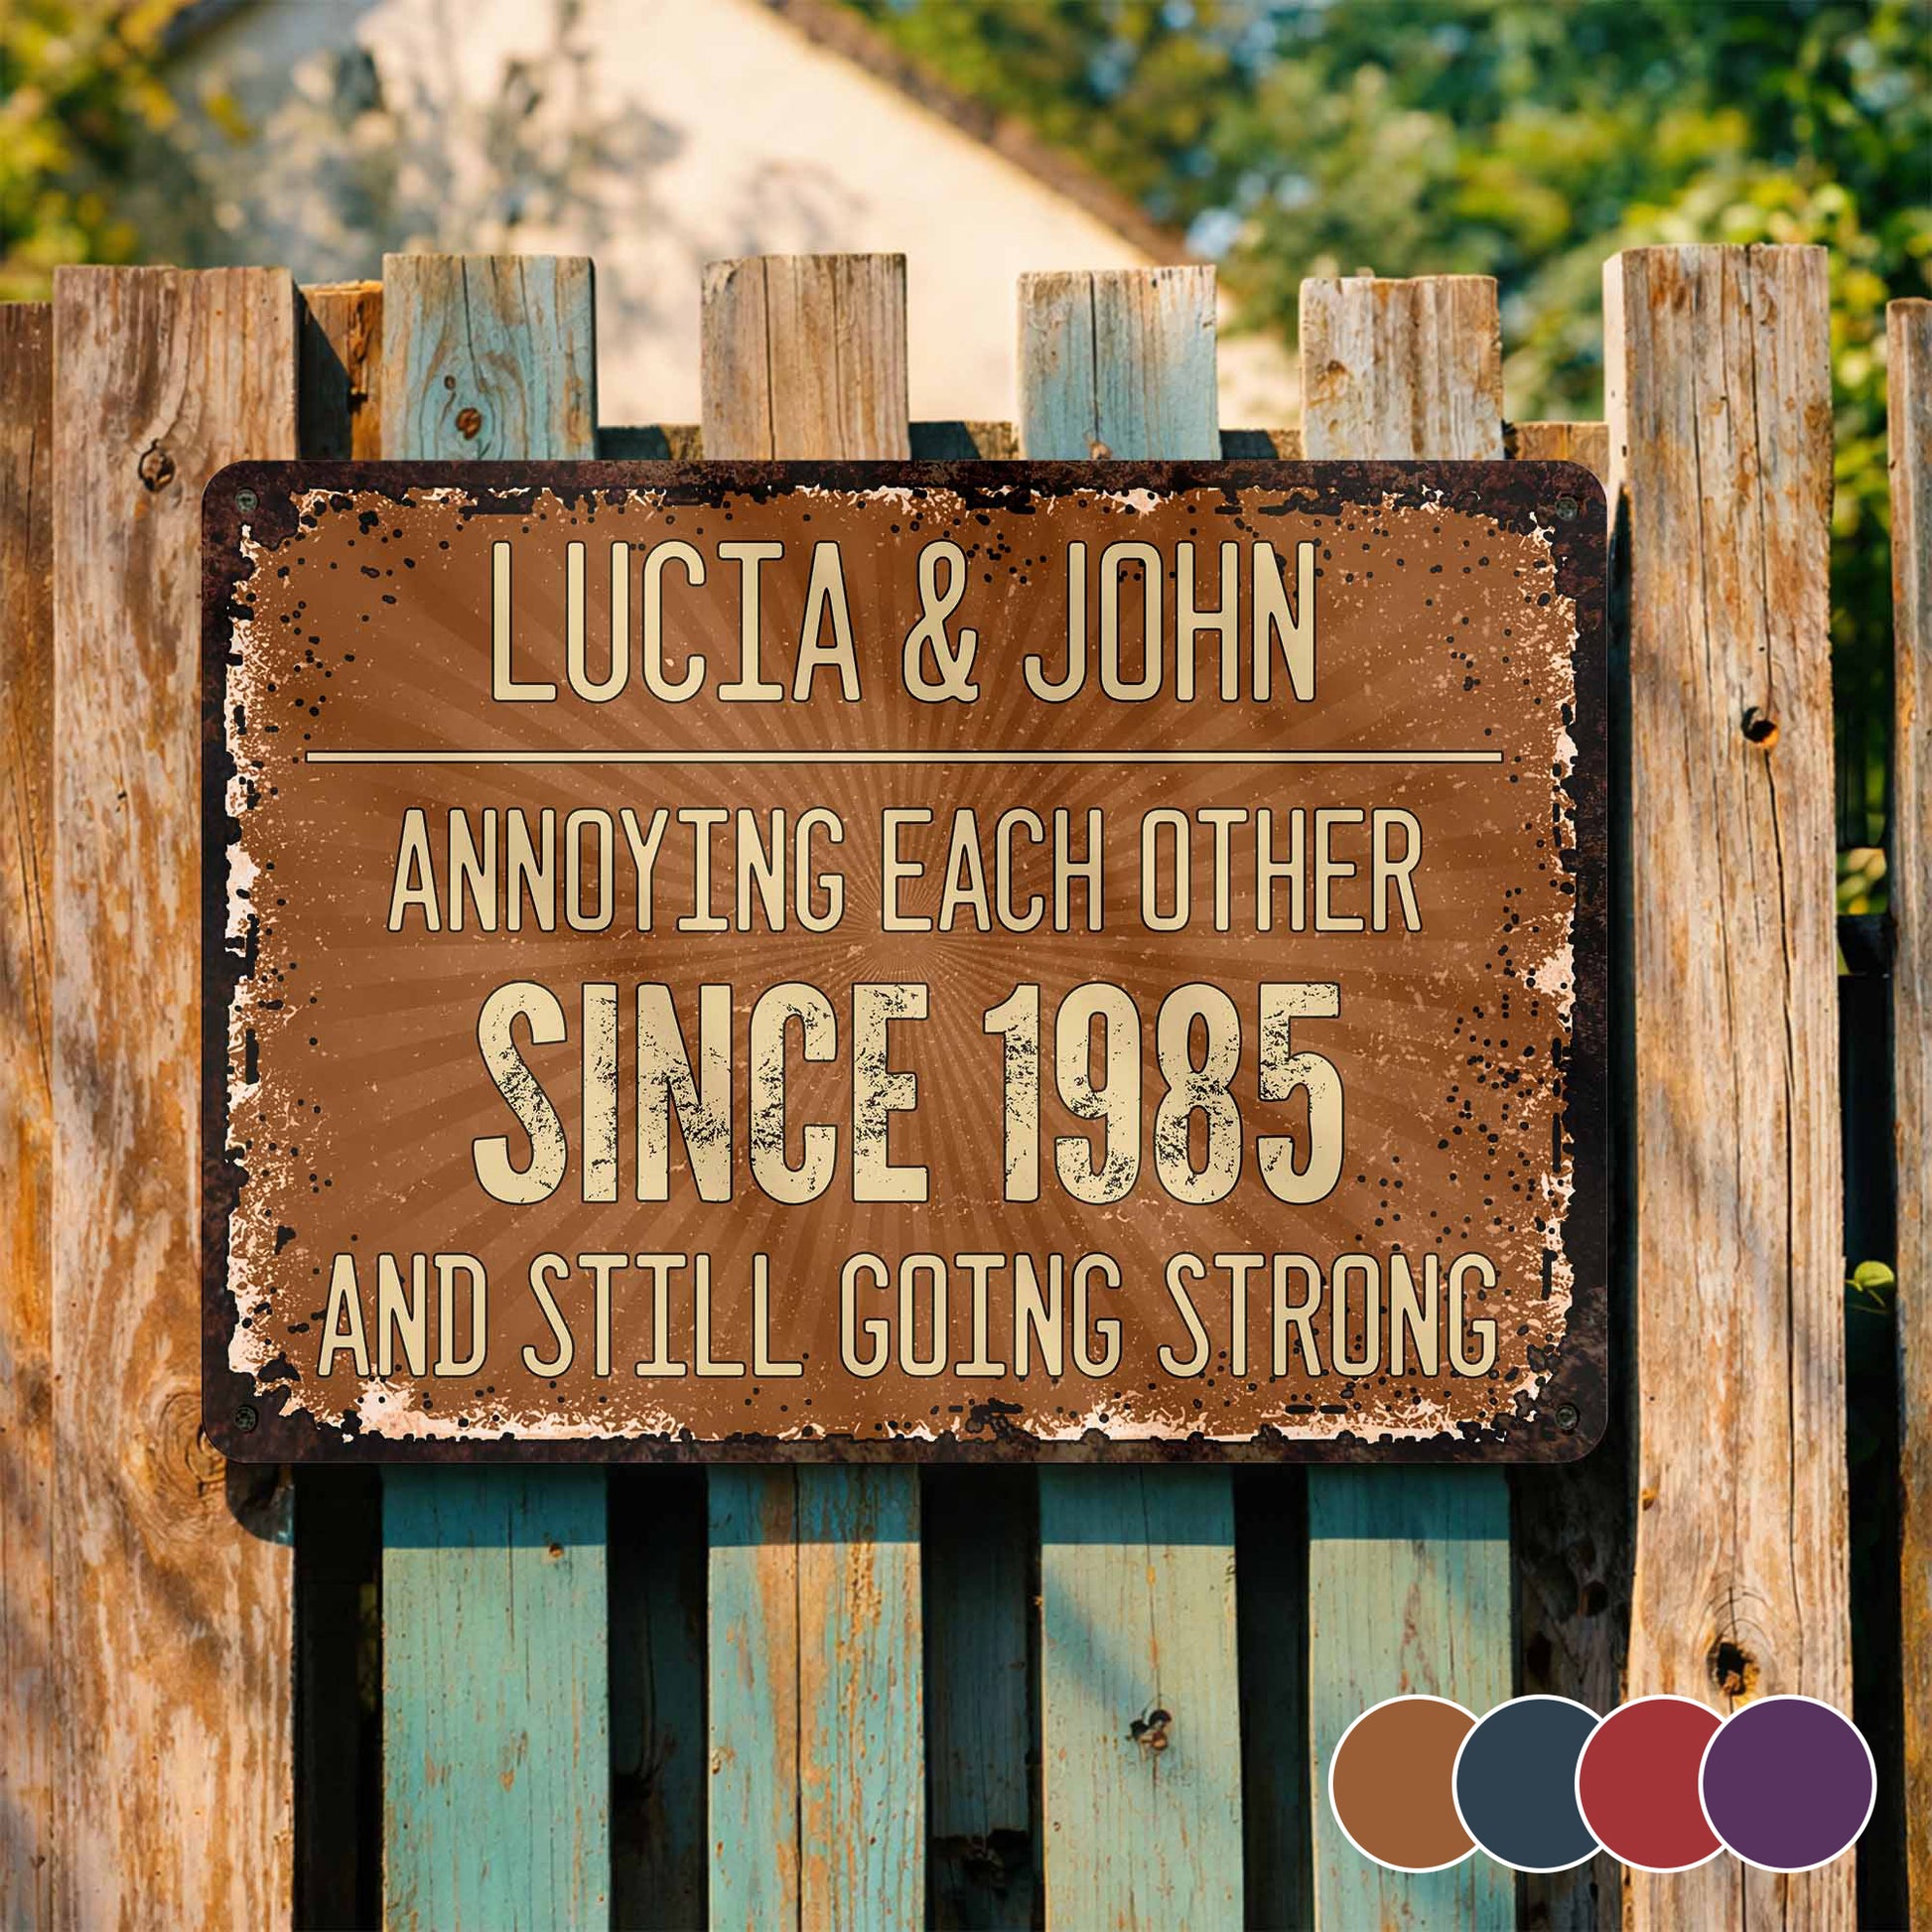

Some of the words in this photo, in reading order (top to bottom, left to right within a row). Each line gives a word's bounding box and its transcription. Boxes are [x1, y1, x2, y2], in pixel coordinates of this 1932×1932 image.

[492, 540, 861, 703] LUCIA
[902, 540, 979, 703] &
[1024, 540, 1315, 703] JOHN
[388, 807, 844, 932] ANNOYING
[882, 807, 1104, 932] EACH
[1141, 807, 1423, 932] OTHER
[473, 981, 928, 1204] SINCE
[983, 981, 1343, 1204] 1985
[318, 1253, 486, 1378] AND
[522, 1253, 803, 1378] STILL
[841, 1253, 1121, 1378] GOING
[1159, 1253, 1497, 1378] STRONG
